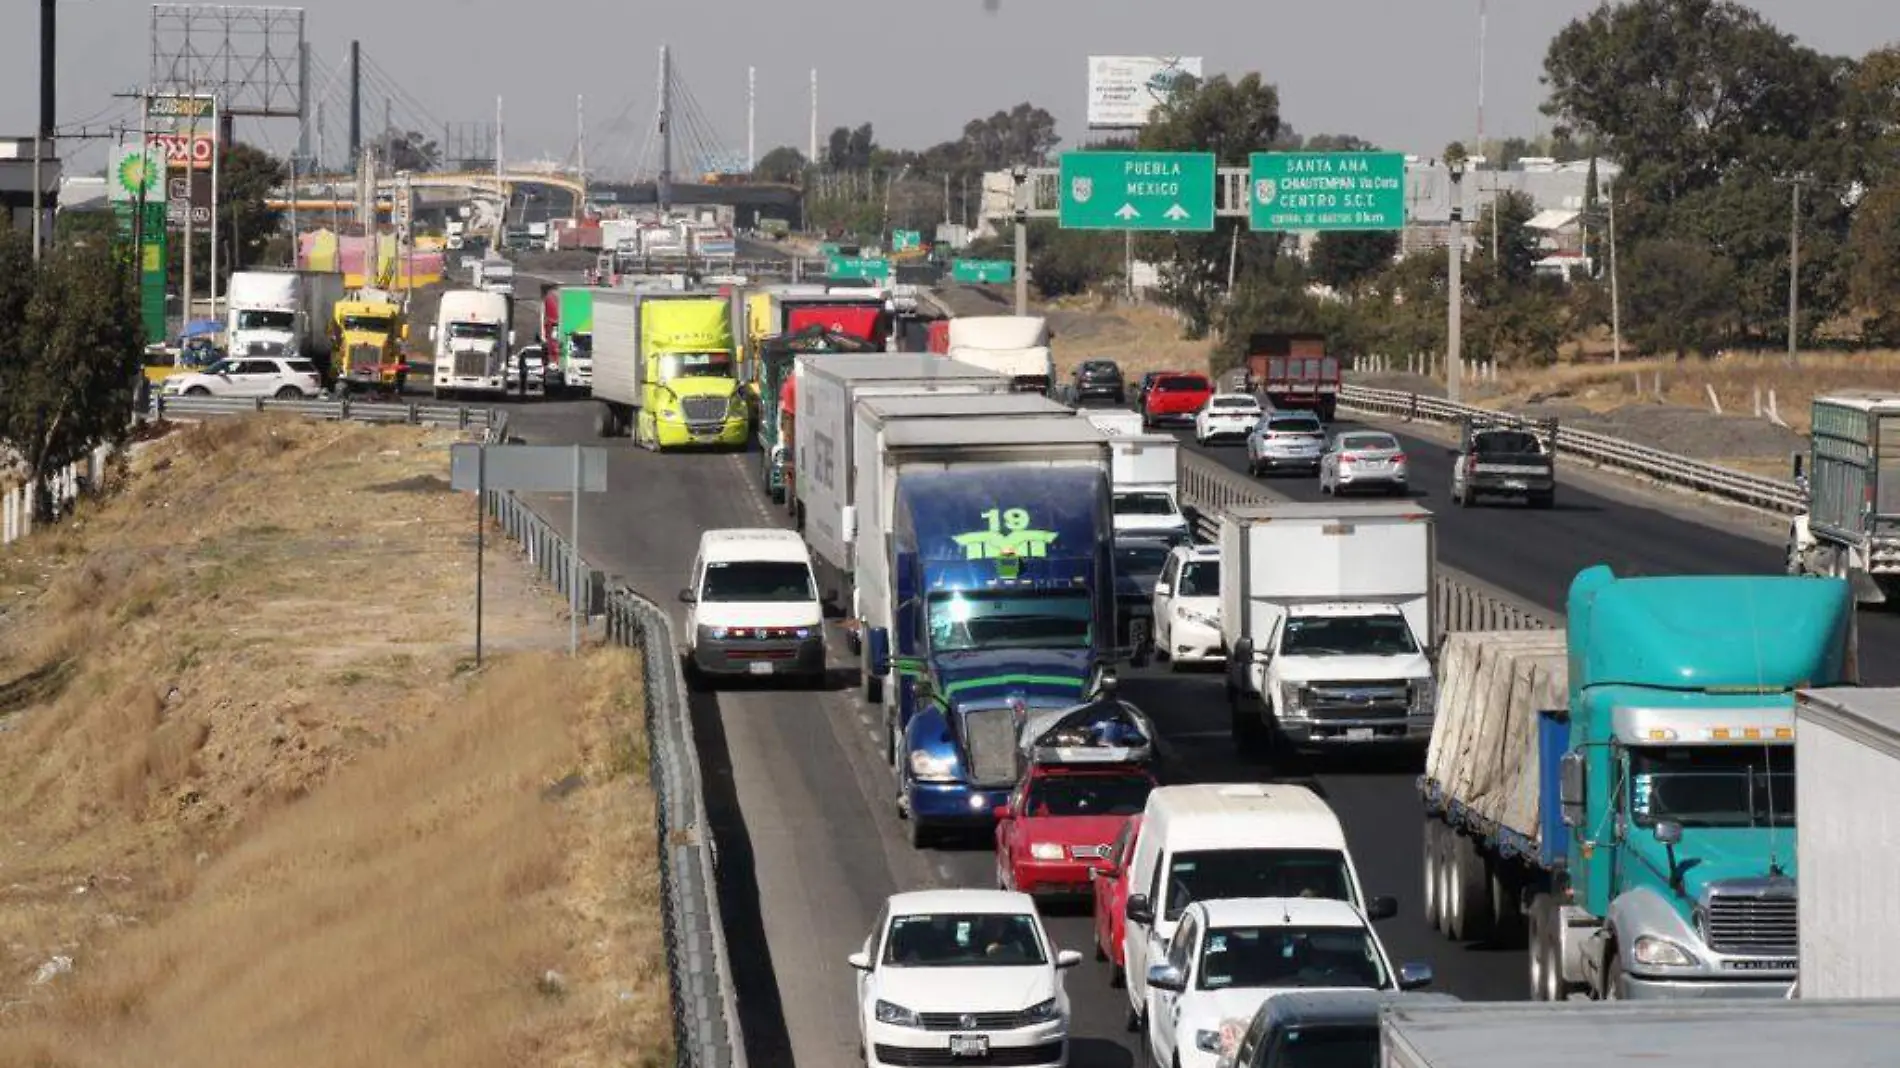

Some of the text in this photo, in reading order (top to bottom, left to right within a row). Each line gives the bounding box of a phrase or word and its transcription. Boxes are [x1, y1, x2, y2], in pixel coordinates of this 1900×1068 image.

[1124, 160, 1181, 175] PUEBLA
[1287, 158, 1368, 173] SANTA ANA
[1126, 181, 1178, 196] MEXICO
[1280, 194, 1336, 207] CENTRO
[981, 507, 1031, 532] 19
